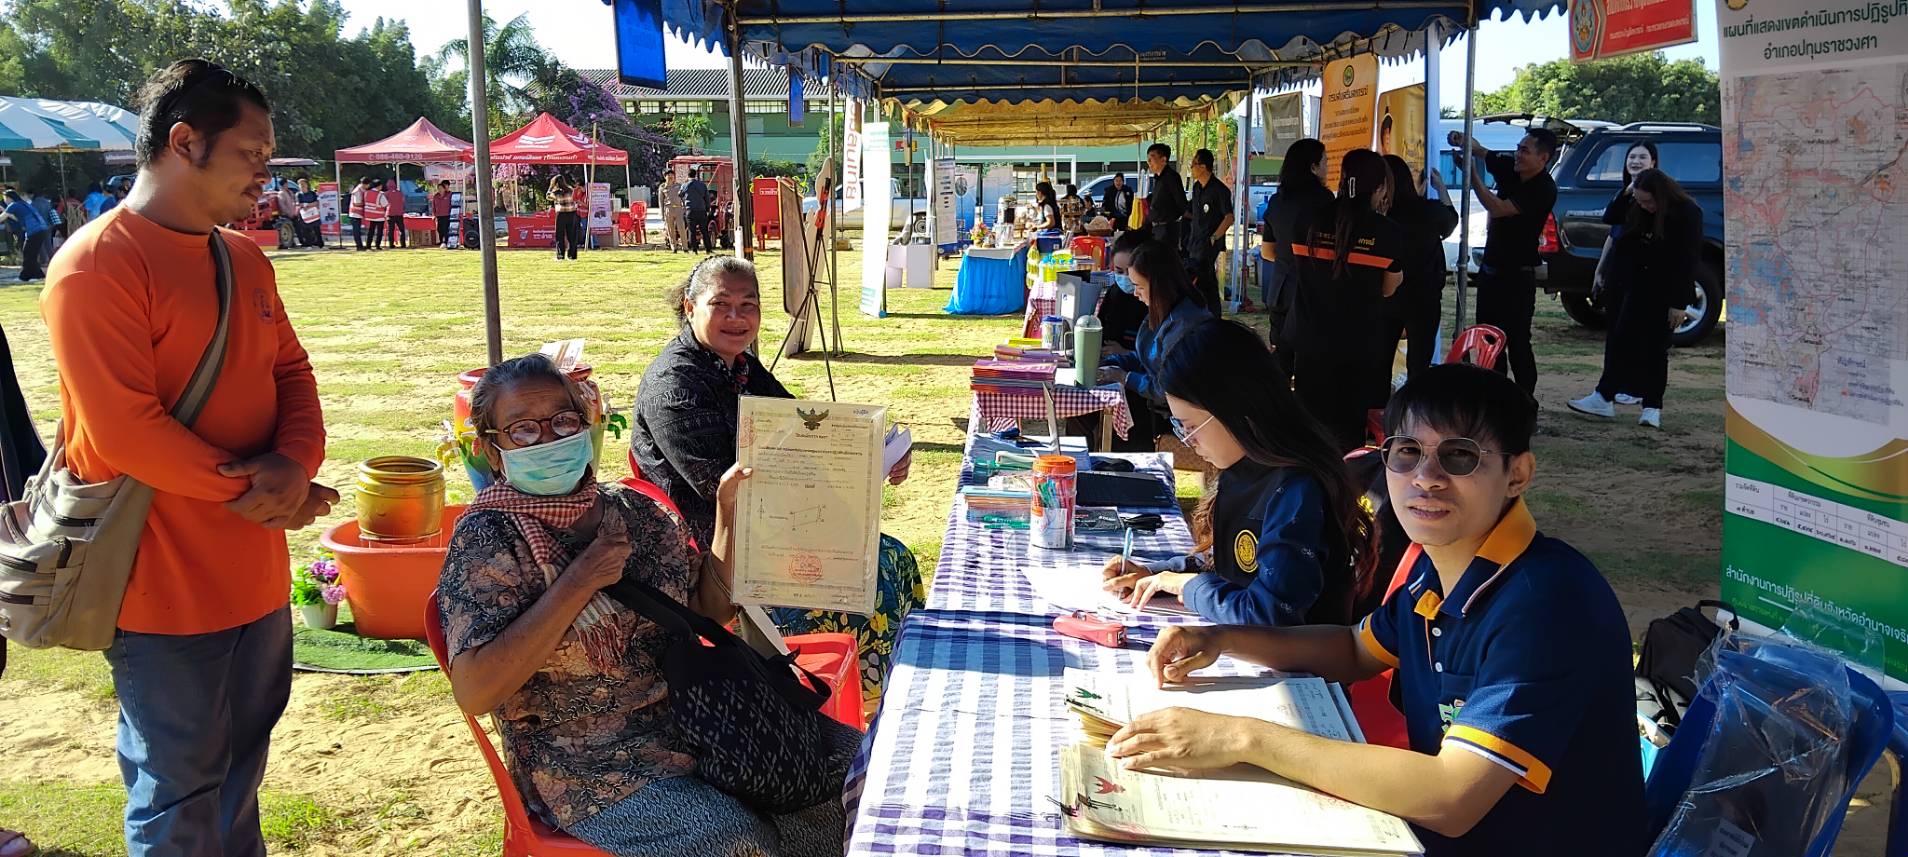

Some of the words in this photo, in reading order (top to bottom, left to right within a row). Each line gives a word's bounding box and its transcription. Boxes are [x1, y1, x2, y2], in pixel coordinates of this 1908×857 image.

[1764, 35, 1877, 60] อำเภอปทุมราชวงศา
